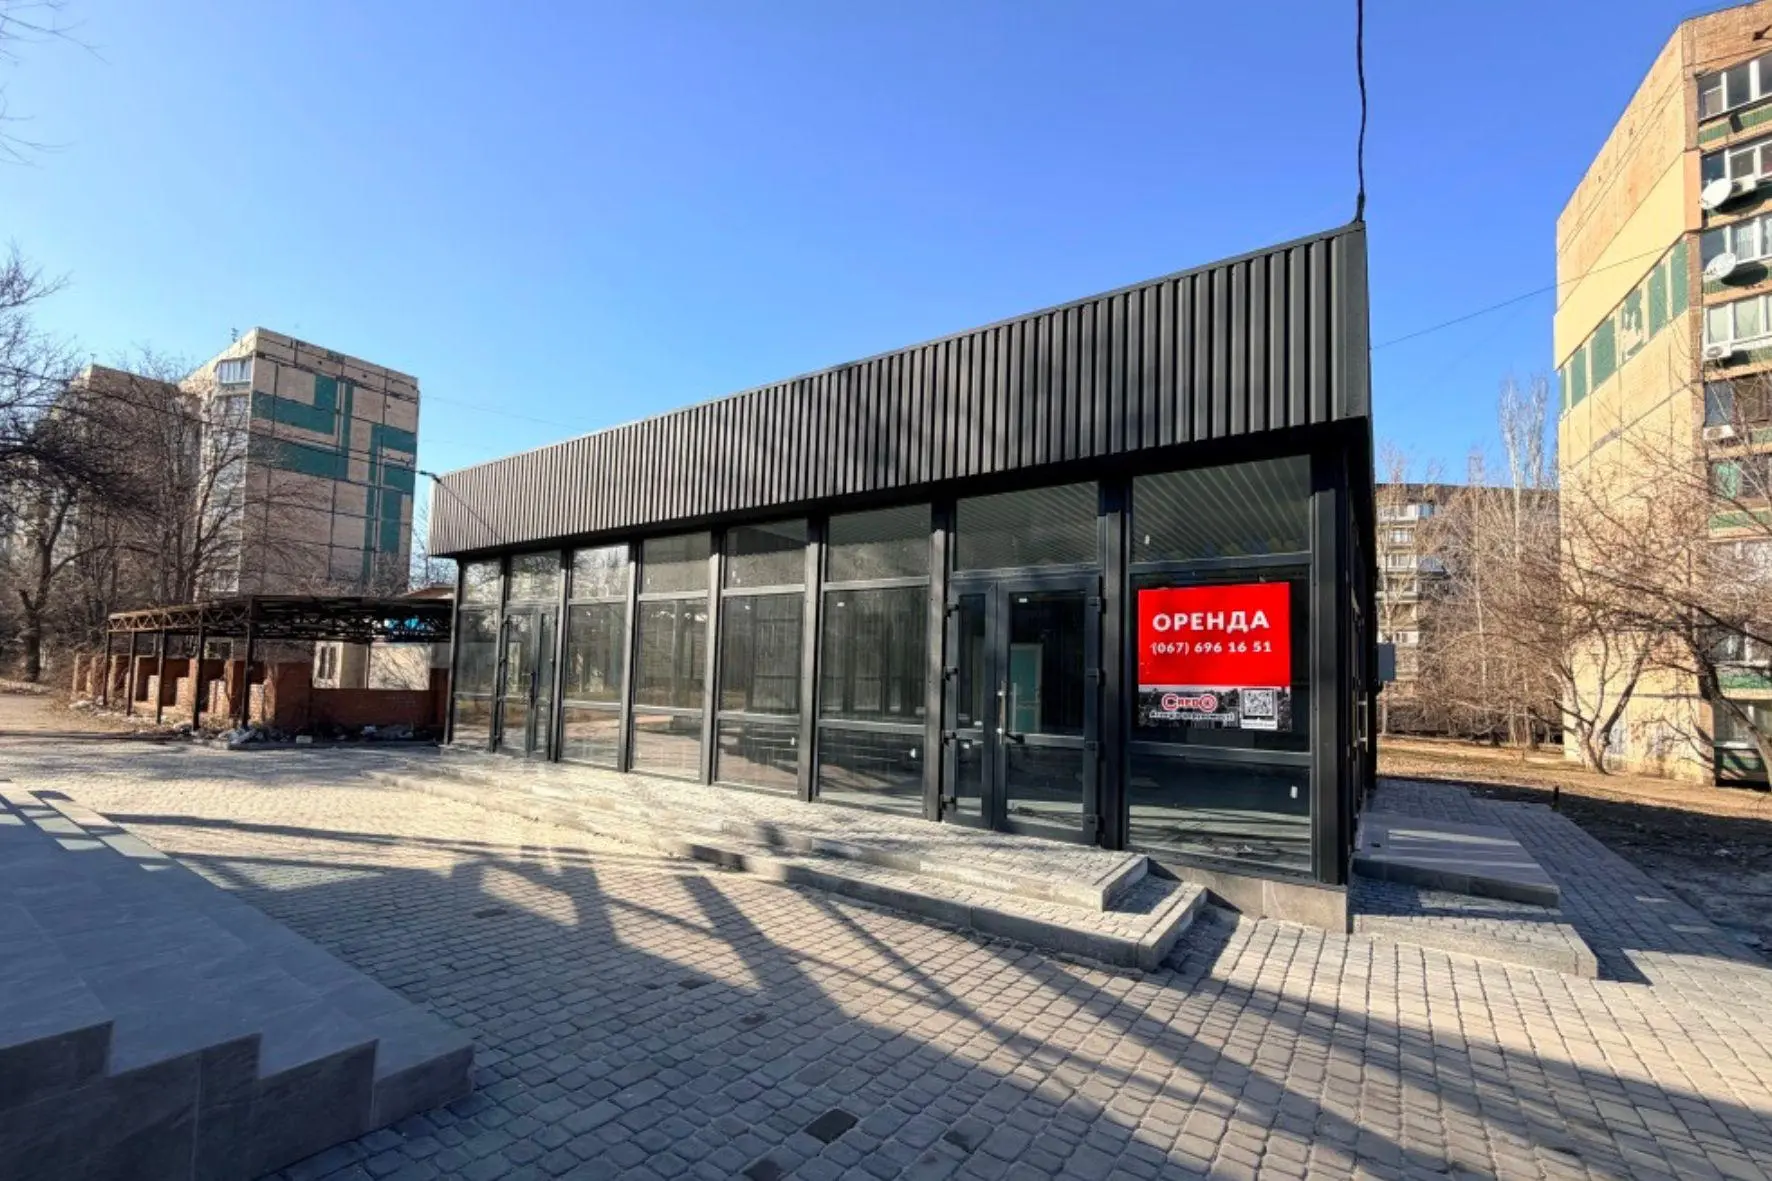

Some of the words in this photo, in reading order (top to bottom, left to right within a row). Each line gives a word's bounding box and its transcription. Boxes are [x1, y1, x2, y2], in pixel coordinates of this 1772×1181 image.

[1152, 610, 1270, 634] ОРЕНДА
[1151, 642, 1190, 655] (067)
[1194, 641, 1222, 653] 696
[1228, 641, 1247, 653] 16
[1252, 640, 1272, 653] 51
